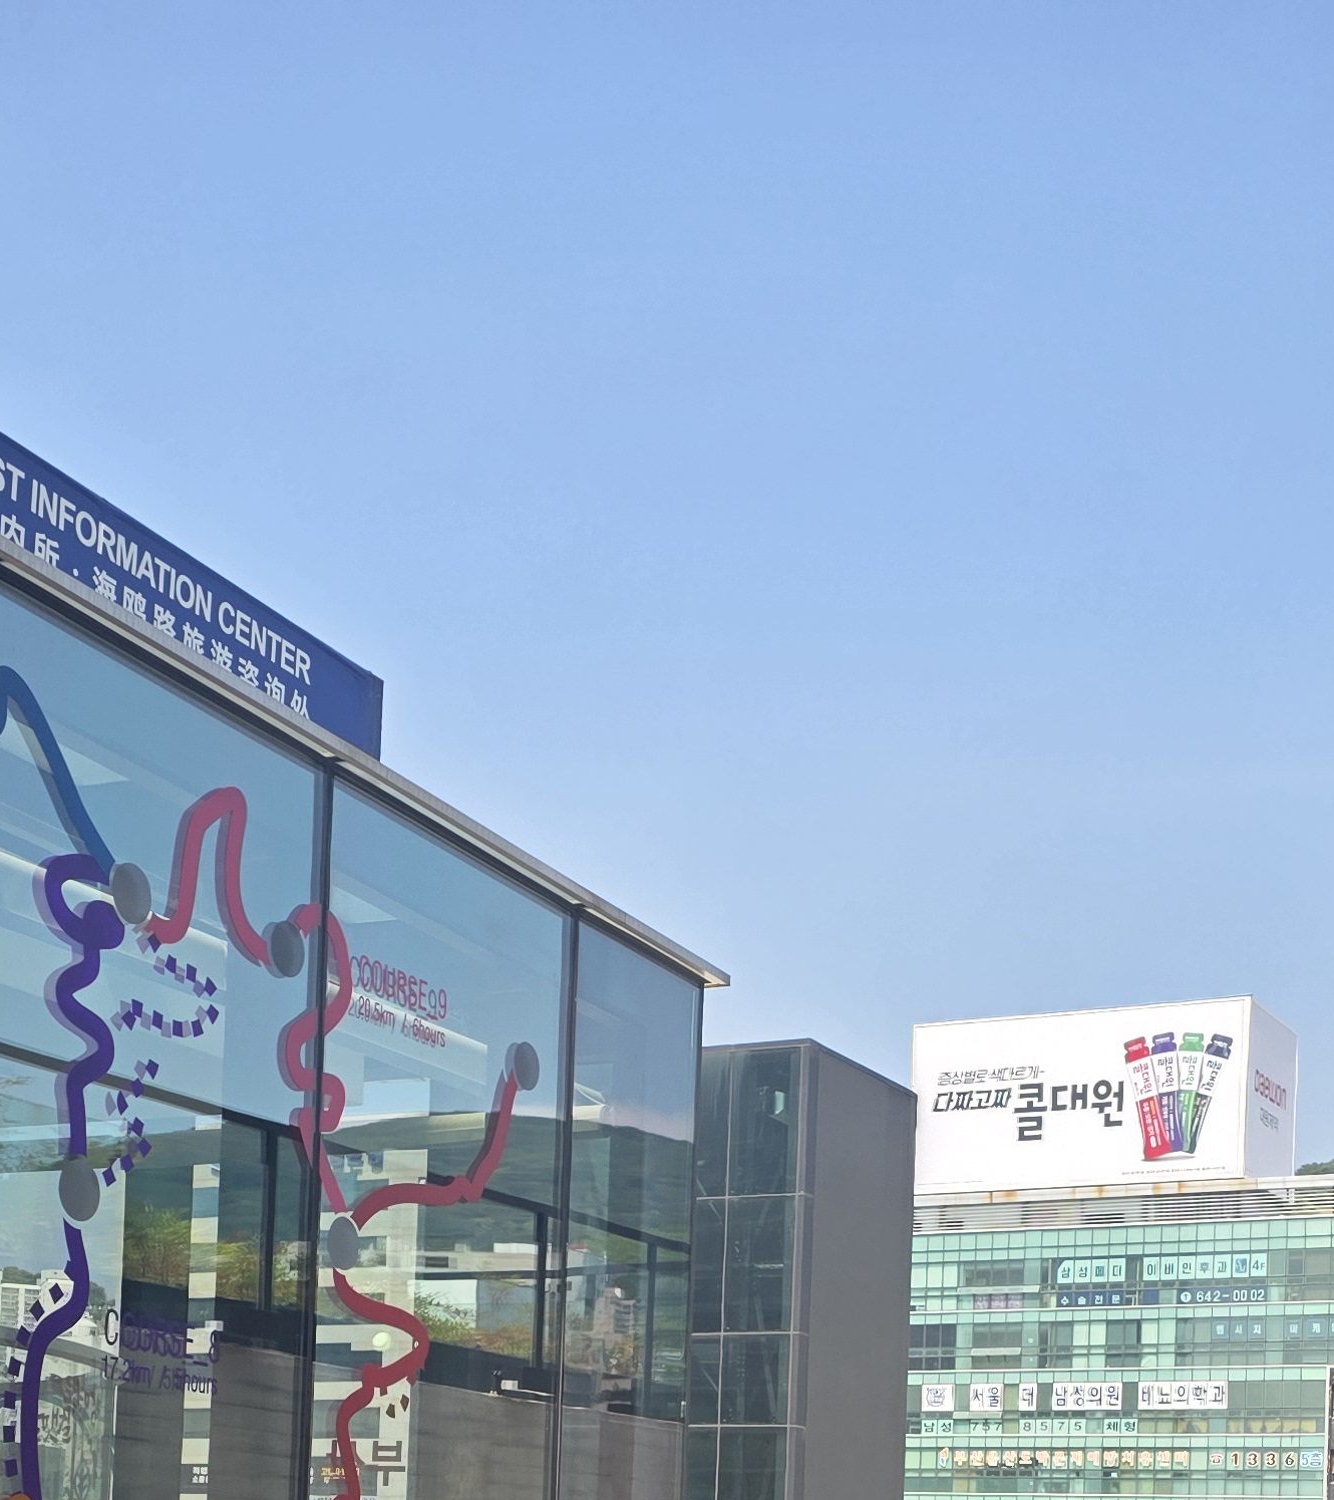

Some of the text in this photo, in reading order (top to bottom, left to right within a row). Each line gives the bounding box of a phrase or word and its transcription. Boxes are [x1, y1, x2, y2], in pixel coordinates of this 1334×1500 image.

[30, 478, 213, 623] INFORMATION
[218, 601, 311, 686] CENTER
[932, 1088, 1012, 1113] 다짜고짜
[1014, 1079, 1125, 1141] 콜대원
[1196, 1289, 1265, 1303] 642-0002
[972, 1386, 1000, 1408] 서울
[923, 1421, 952, 1433] 남성
[1022, 1420, 1082, 1432] 8575
[1231, 1452, 1295, 1467] 1336
